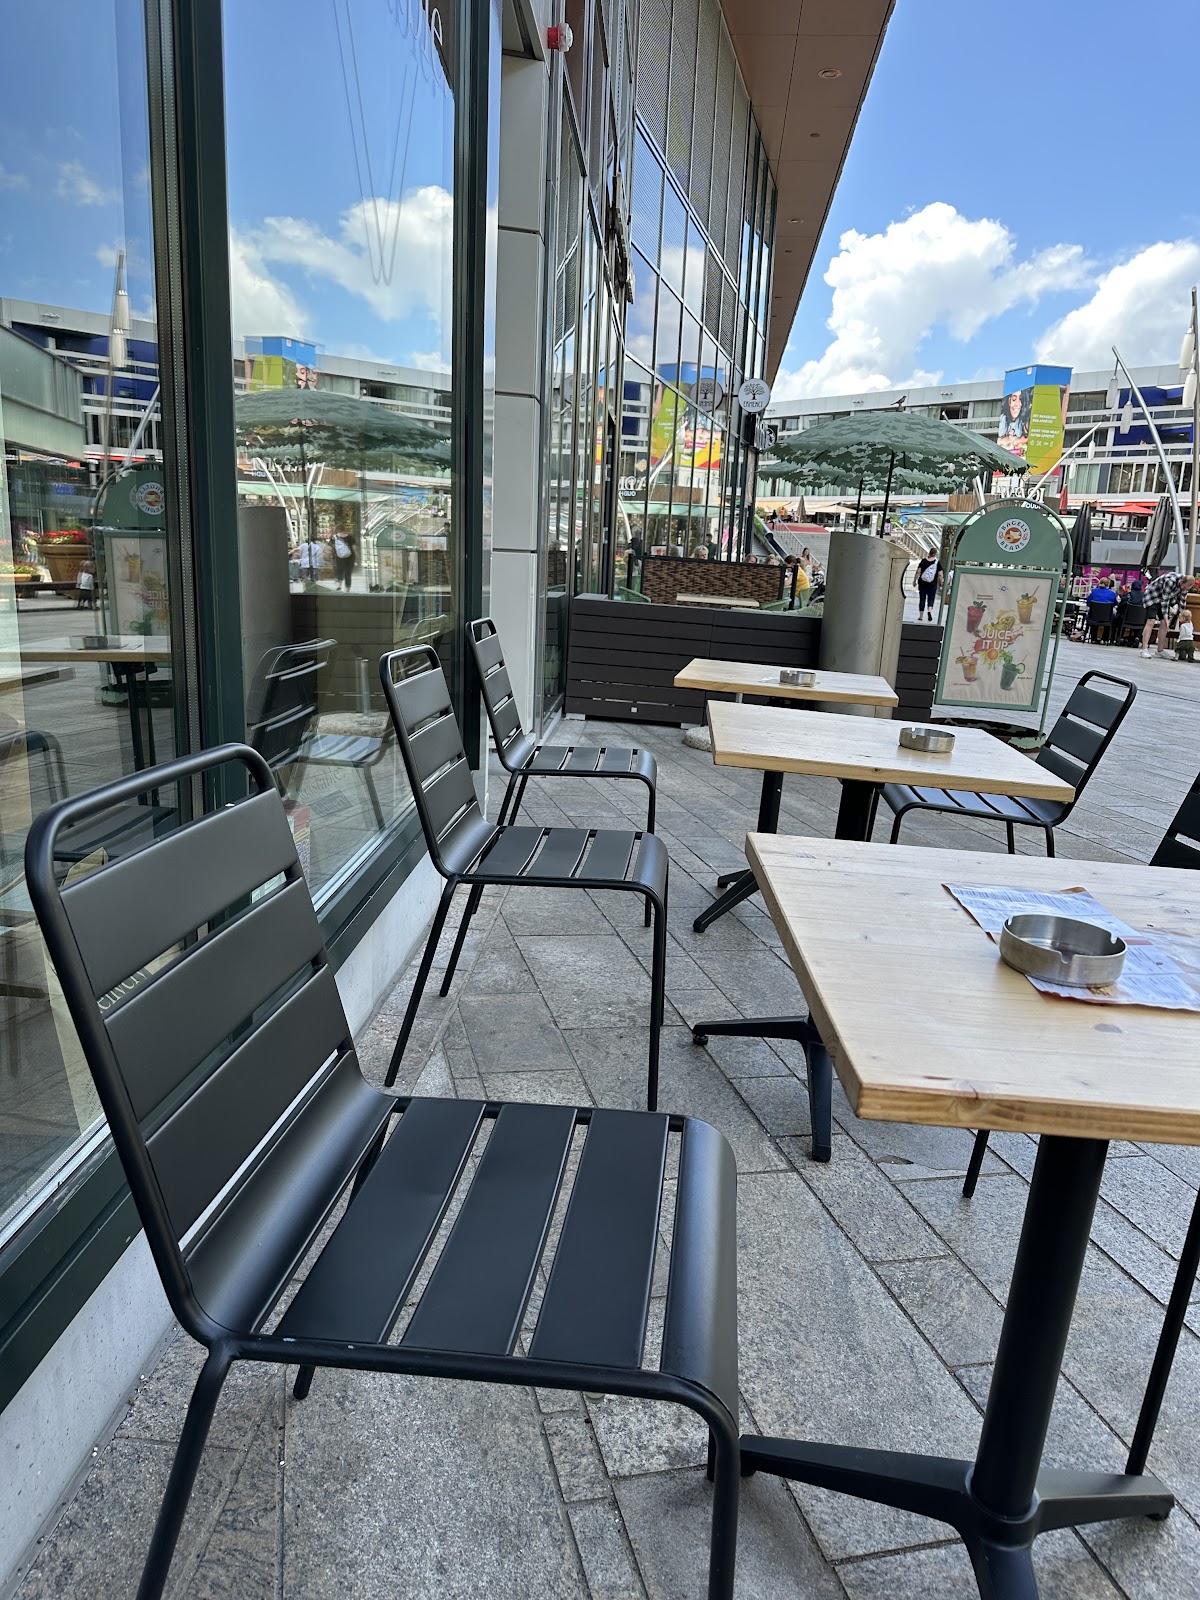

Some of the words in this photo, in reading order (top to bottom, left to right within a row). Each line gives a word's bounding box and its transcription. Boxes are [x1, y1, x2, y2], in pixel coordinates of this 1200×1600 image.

[1001, 520, 1028, 532] BAGELS
[1000, 540, 1025, 551] BEANS
[980, 629, 1011, 640] JUICE
[982, 639, 992, 650] IT
[993, 640, 1009, 650] UP
